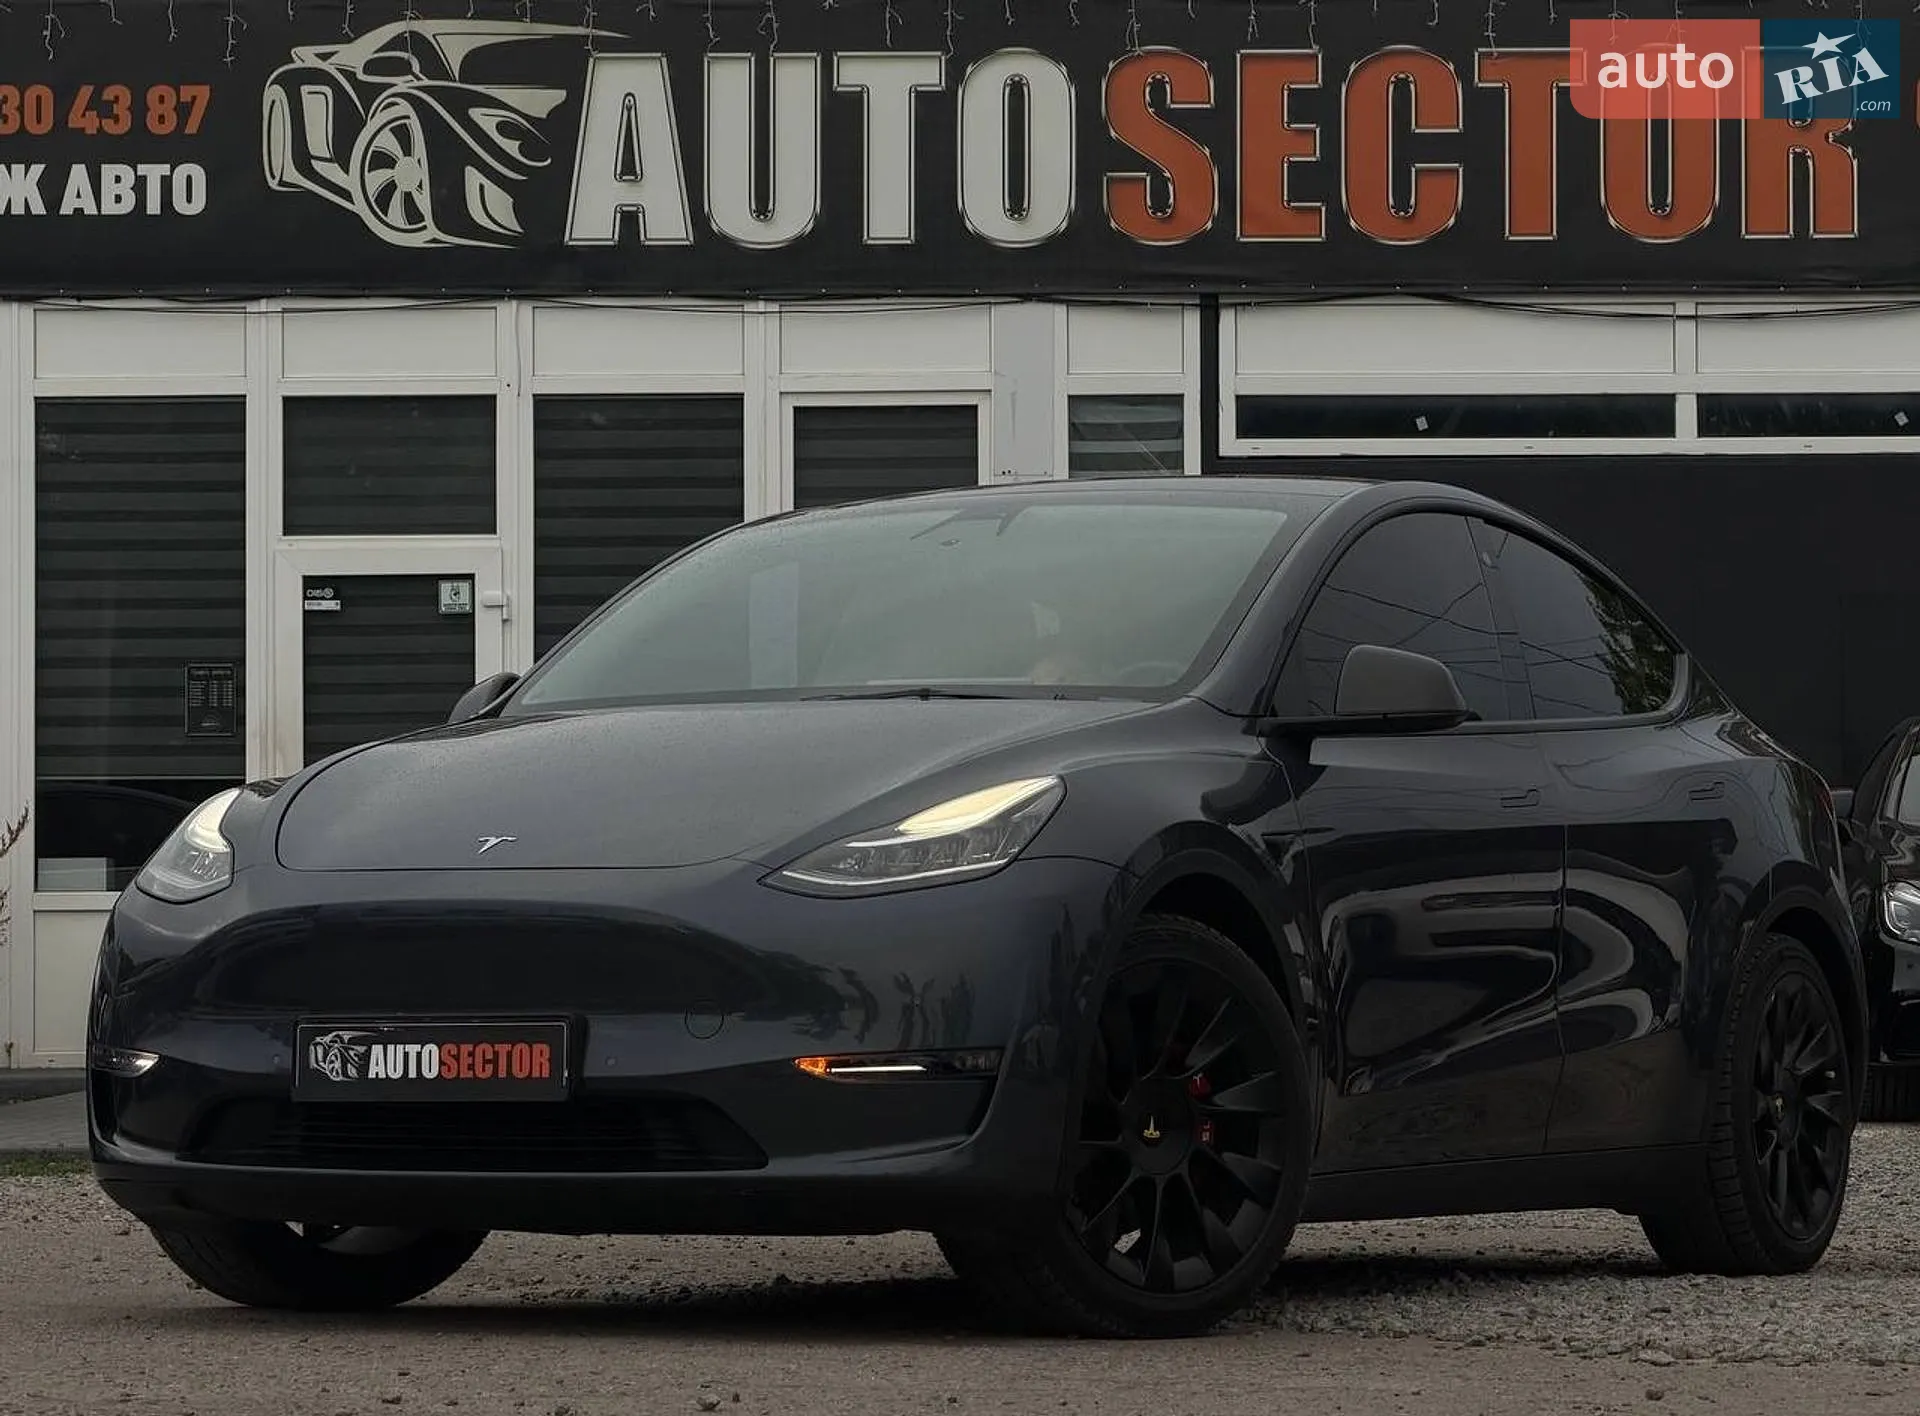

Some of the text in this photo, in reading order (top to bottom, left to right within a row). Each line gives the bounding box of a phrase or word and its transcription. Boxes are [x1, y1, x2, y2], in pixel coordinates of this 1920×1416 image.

[68, 84, 133, 136] 43
[146, 84, 211, 136] 87
[59, 163, 207, 216] АВТО
